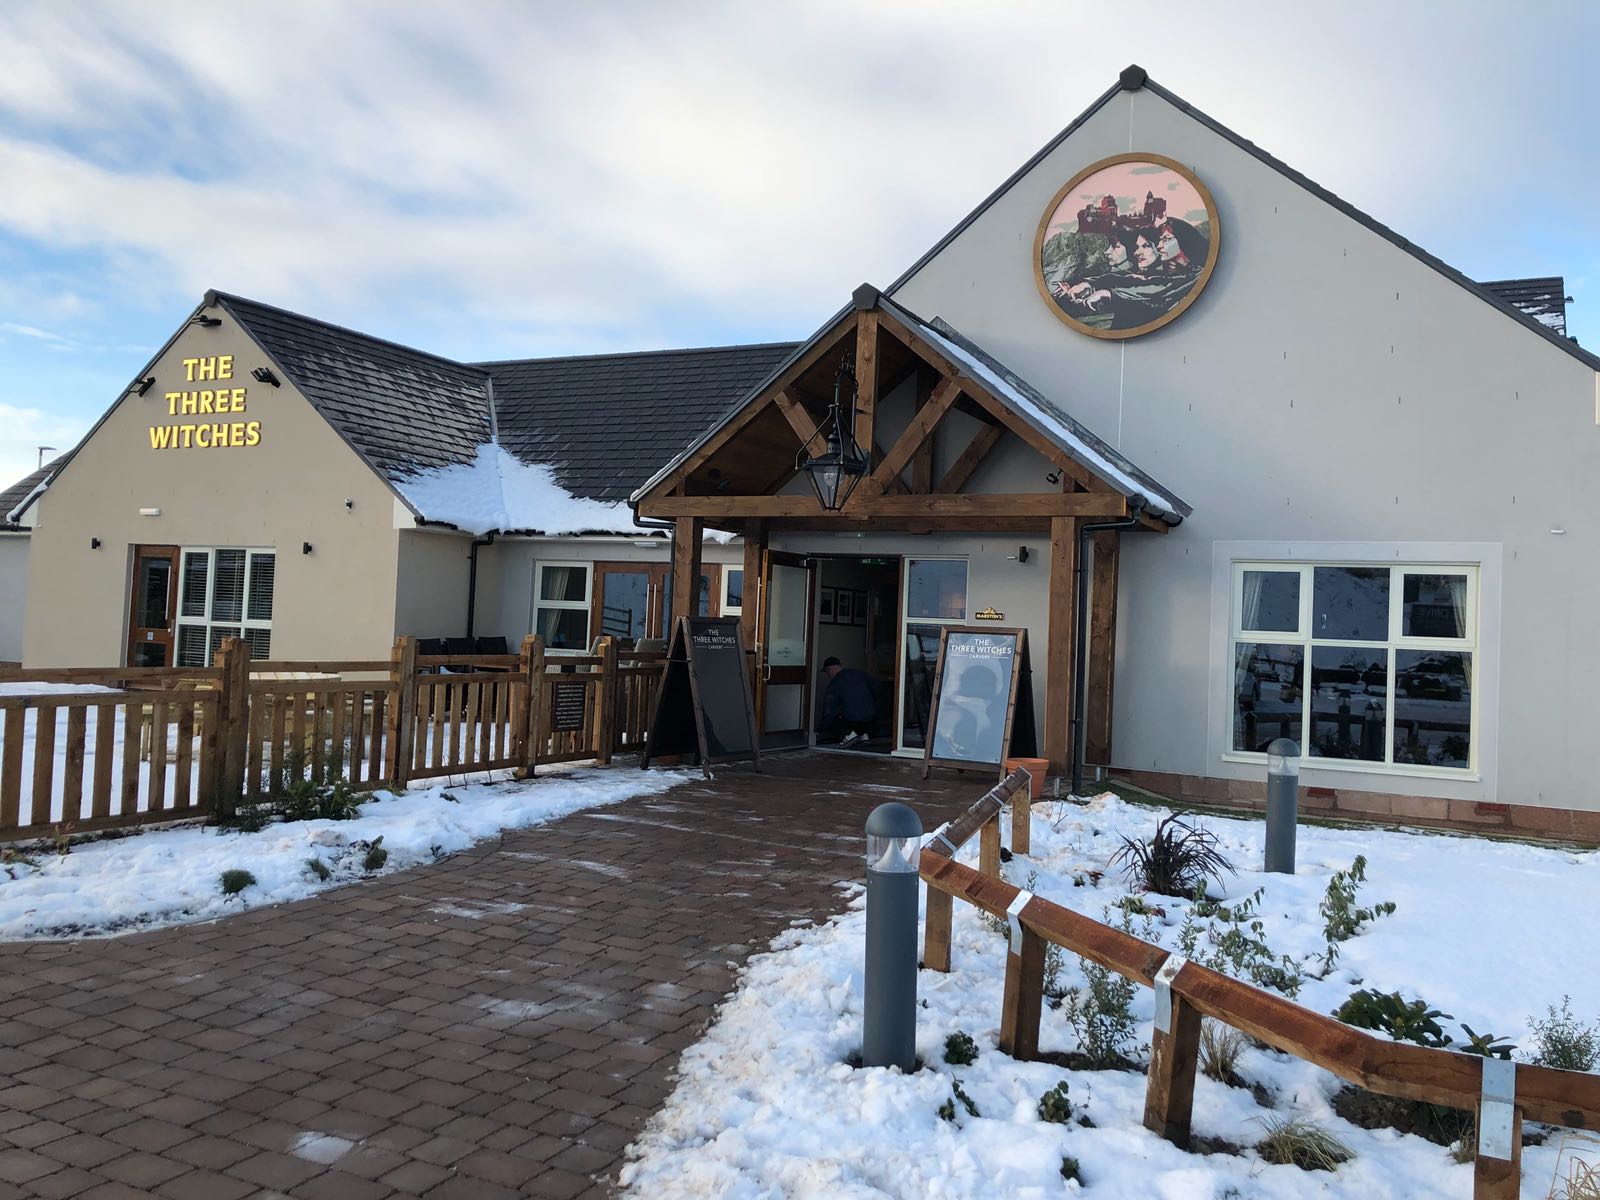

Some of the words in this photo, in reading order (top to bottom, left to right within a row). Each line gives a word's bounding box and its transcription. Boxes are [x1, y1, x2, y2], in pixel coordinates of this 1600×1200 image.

[183, 355, 234, 381] THE
[165, 388, 247, 415] THREE
[149, 421, 262, 449] WITCHES
[712, 636, 736, 644] WITCHES
[976, 646, 1012, 654] WITCHES
